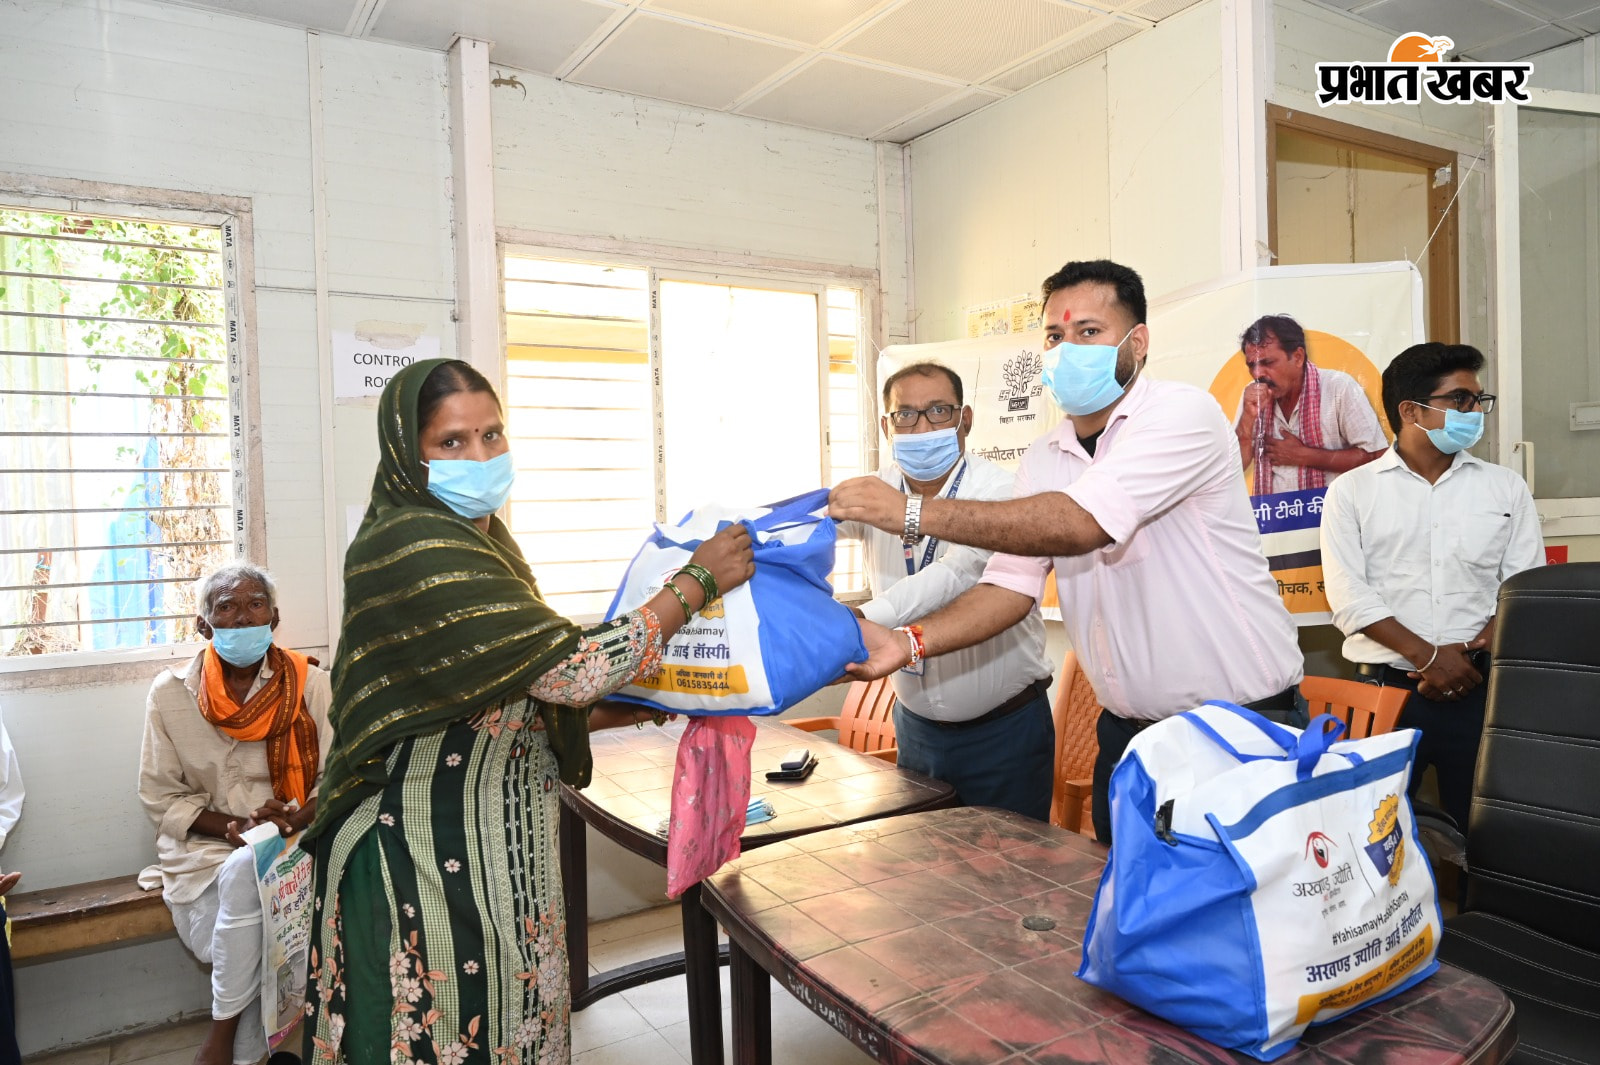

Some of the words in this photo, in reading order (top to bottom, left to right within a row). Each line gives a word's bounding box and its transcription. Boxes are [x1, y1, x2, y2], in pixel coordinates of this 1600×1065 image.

[229, 320, 237, 343] MATA
[233, 415, 241, 437] MATA
[1275, 498, 1304, 519] टीबी
[236, 509, 244, 532] MATA
[672, 642, 690, 659] आई
[1305, 954, 1352, 983] अखण्ड
[1353, 937, 1382, 967] ज्योति
[1385, 922, 1401, 952] आई
